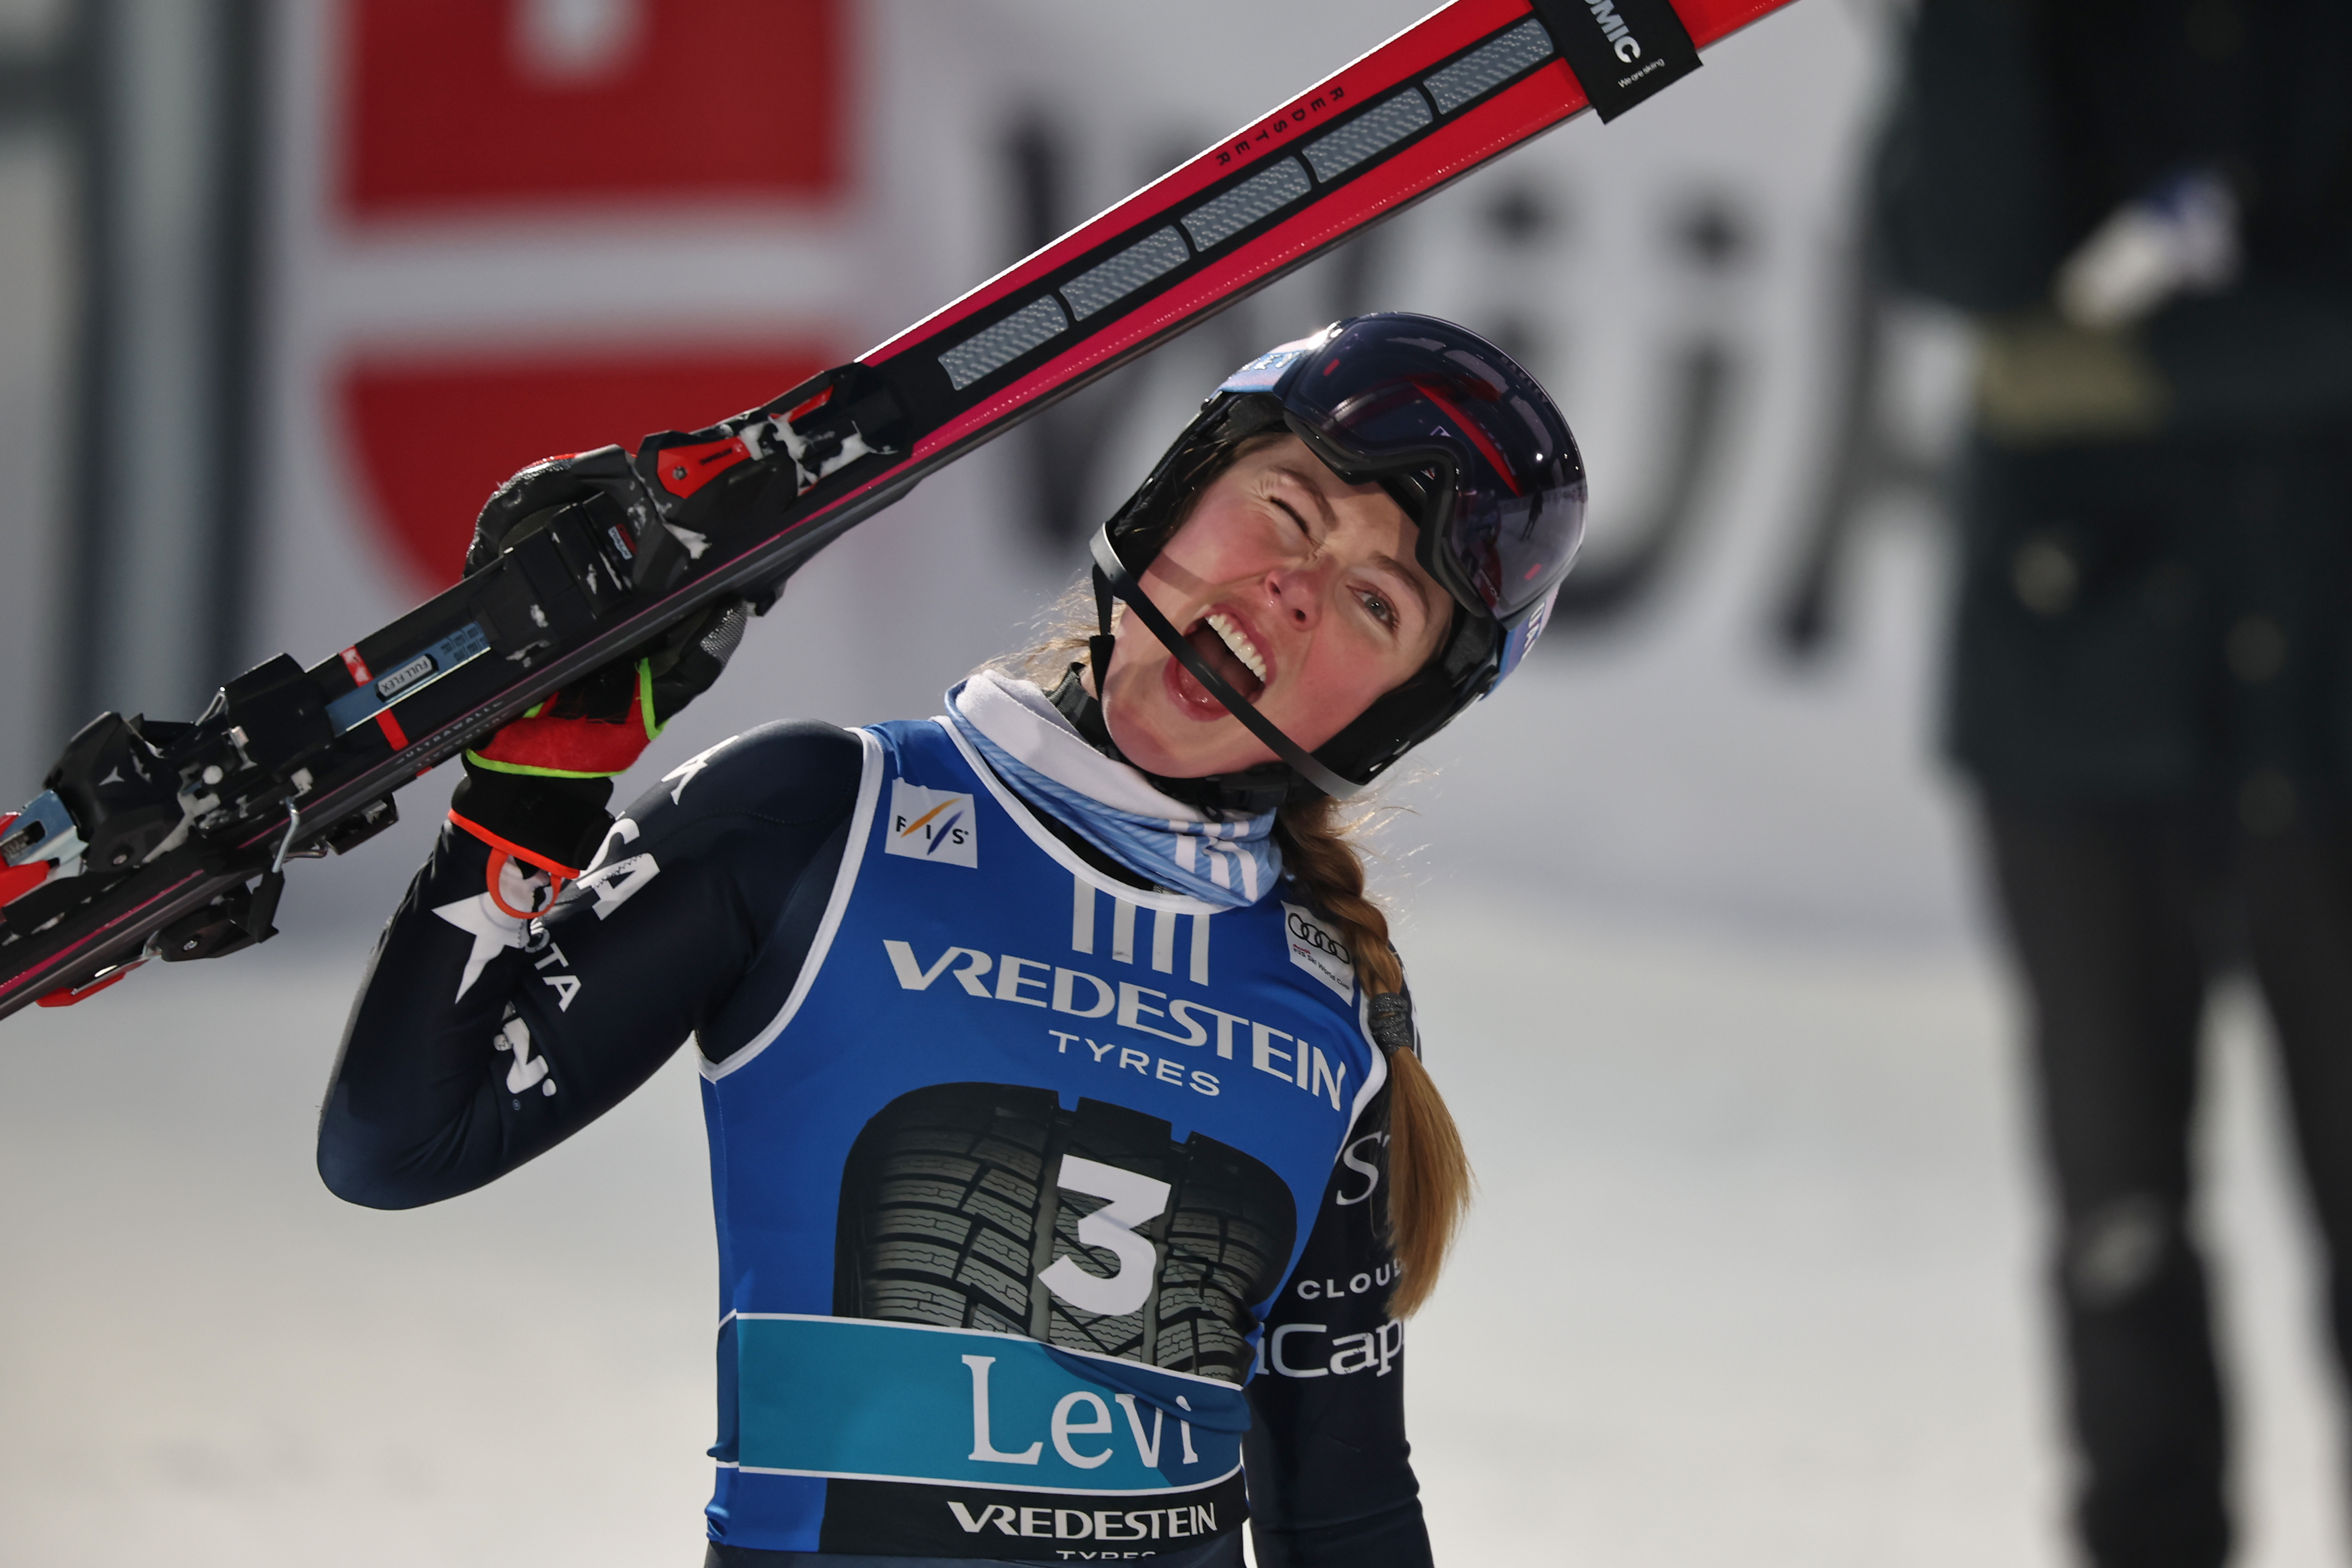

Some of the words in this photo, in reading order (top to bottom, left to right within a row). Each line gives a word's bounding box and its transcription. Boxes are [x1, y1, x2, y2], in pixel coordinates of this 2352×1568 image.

[1583, 0, 1641, 63] MIC
[1216, 87, 1344, 165] REDSTER
[382, 676, 406, 693] FLEX
[409, 660, 429, 677] FULL
[896, 815, 965, 845] FIS
[1293, 948, 1306, 958] FIS
[1307, 955, 1317, 965] Ski
[1318, 961, 1336, 981] World
[1337, 978, 1350, 990] Cup
[883, 939, 1346, 1112] VREDESTEIN
[1048, 1030, 1220, 1097] TYRES
[1037, 1153, 1172, 1316] 3
[961, 1354, 1199, 1470] Levi
[946, 1500, 1218, 1541] VREDESTEIN
